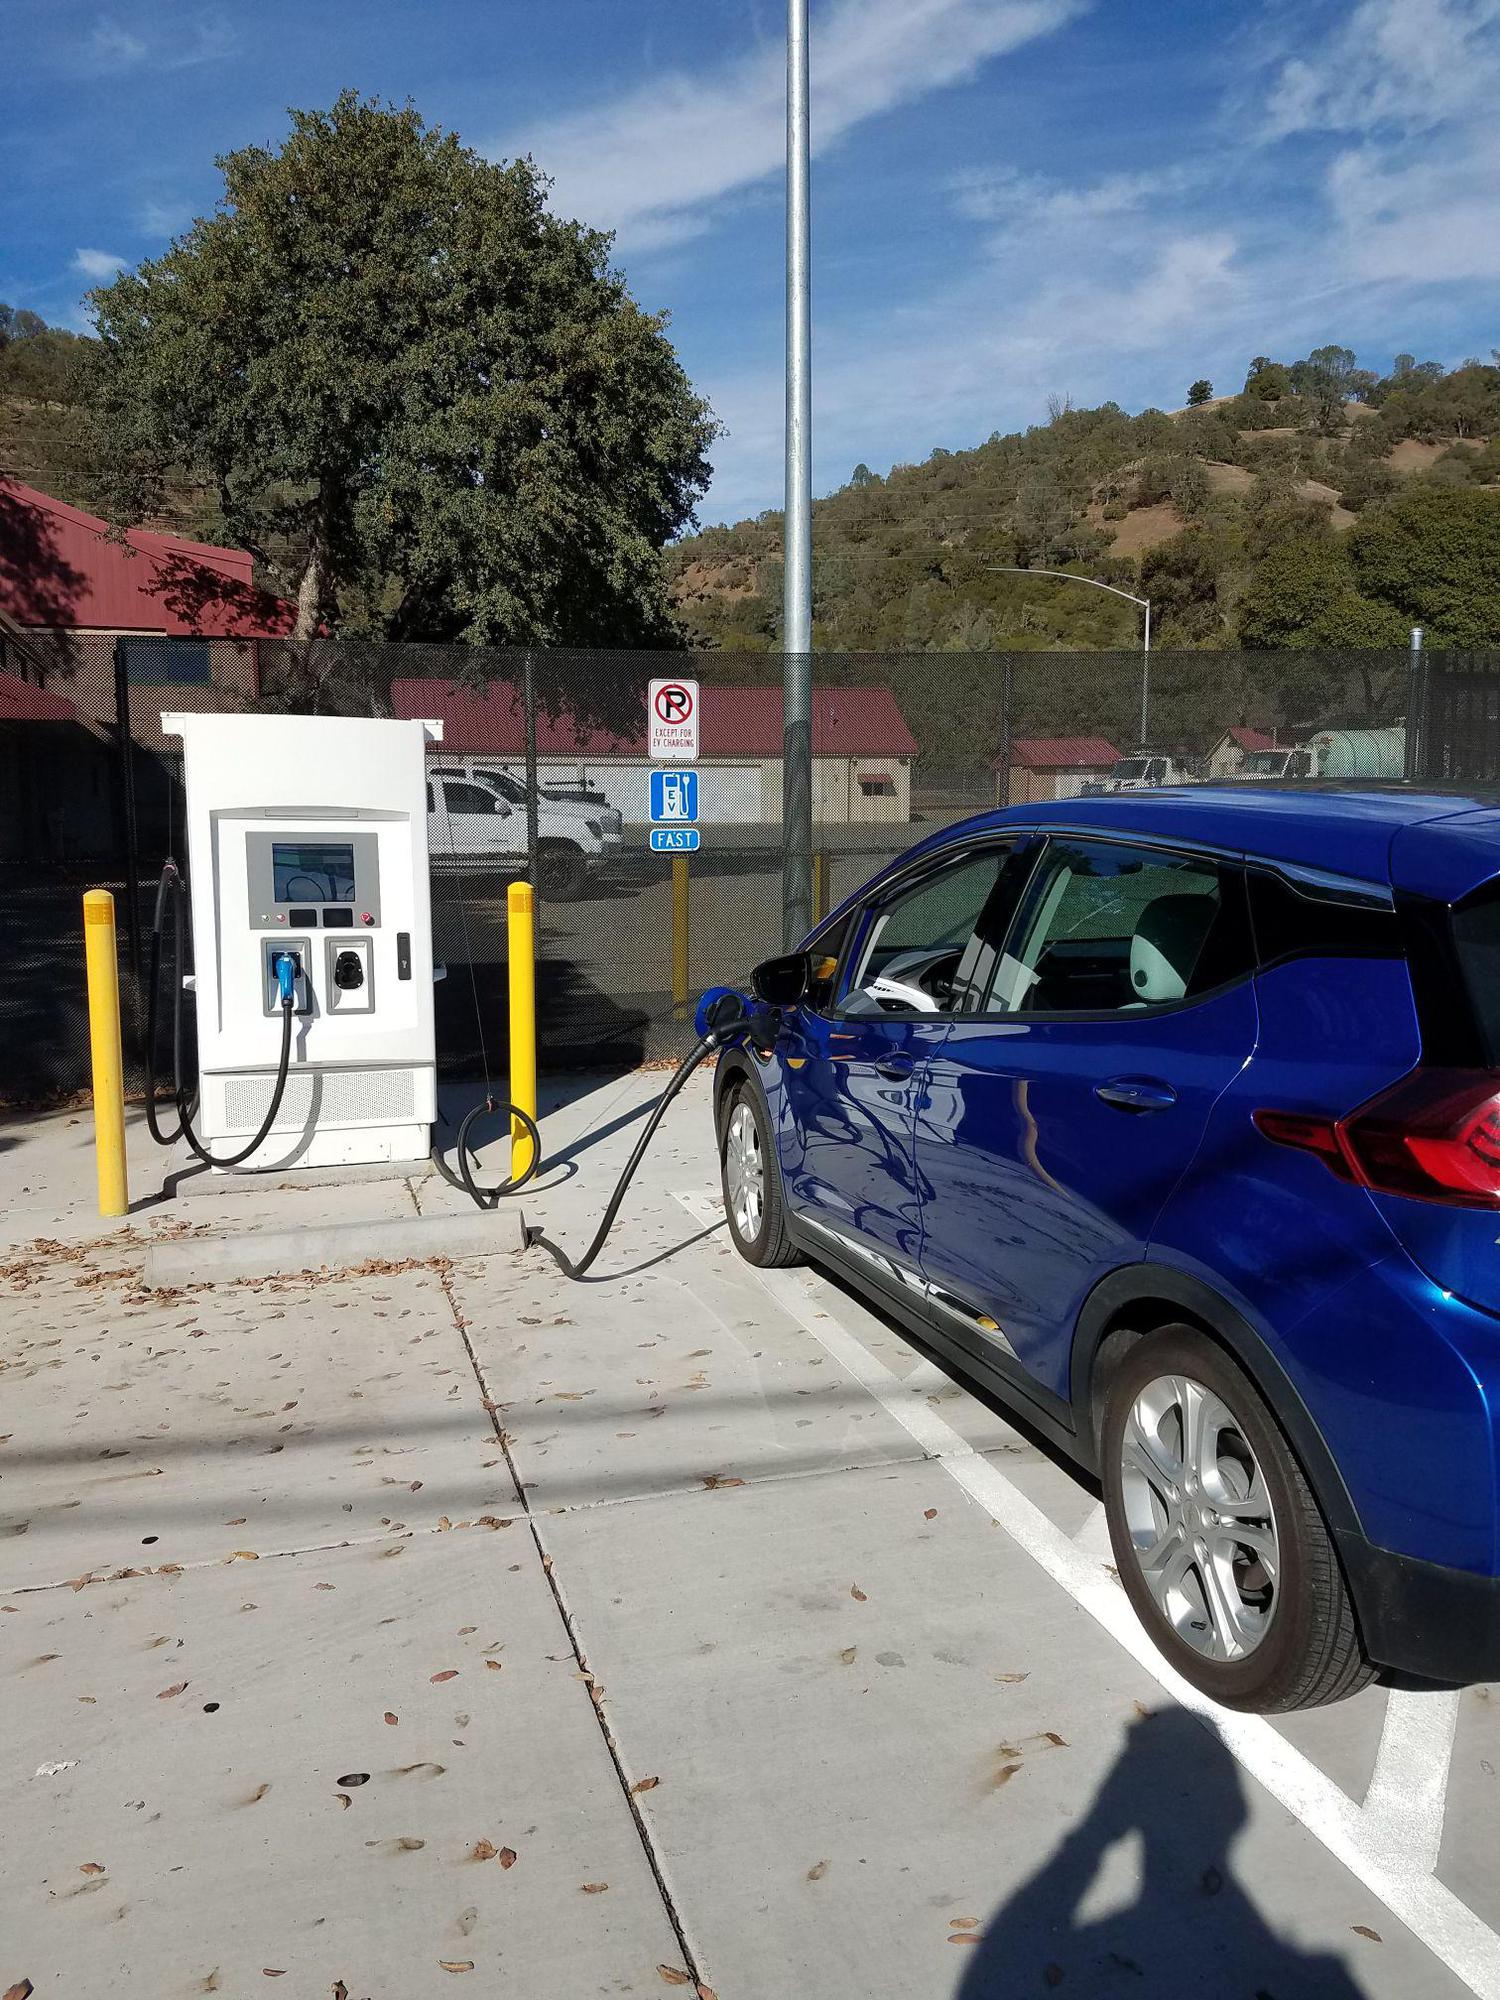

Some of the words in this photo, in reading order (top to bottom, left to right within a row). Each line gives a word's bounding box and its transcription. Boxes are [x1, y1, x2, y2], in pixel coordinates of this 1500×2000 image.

[655, 728, 678, 738] EXCEPT
[680, 728, 692, 738] FOR
[653, 738, 661, 748] EV
[663, 738, 695, 748] CHARGING
[658, 832, 692, 847] FAST
